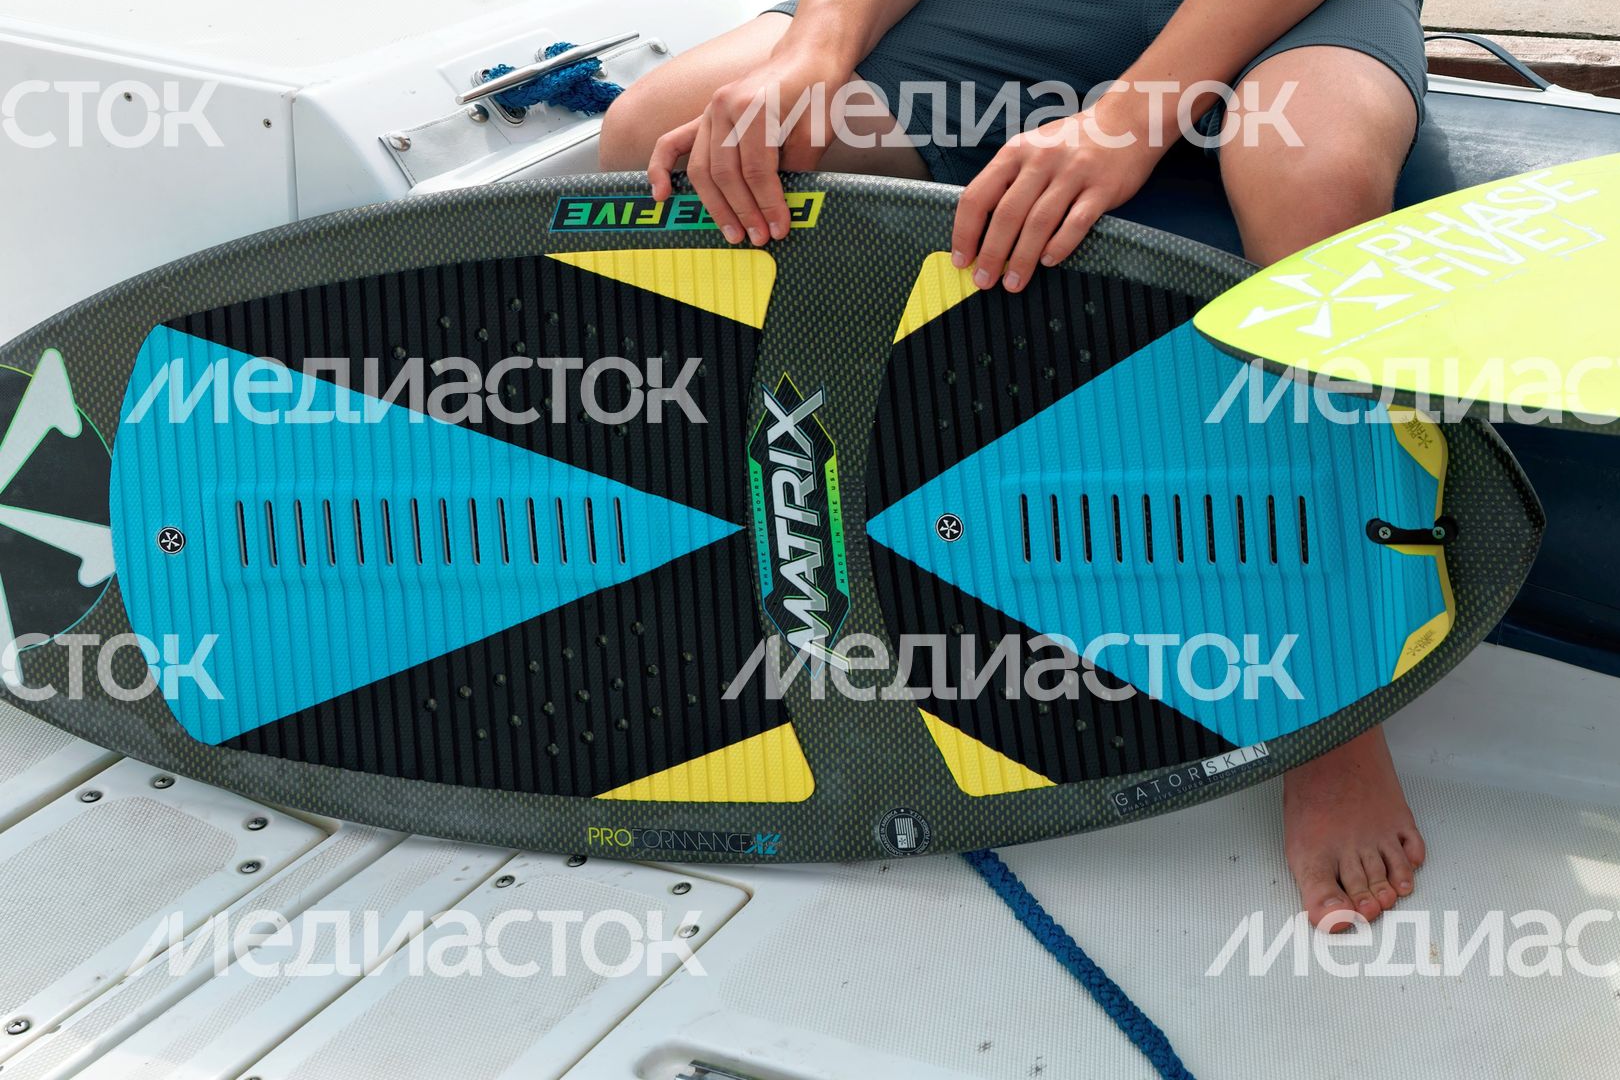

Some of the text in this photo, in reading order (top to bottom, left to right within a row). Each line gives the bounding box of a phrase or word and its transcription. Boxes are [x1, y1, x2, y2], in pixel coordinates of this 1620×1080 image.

[563, 200, 664, 225] FIVE
[1356, 170, 1600, 258] PHASE
[1394, 222, 1570, 292] FIVE
[761, 383, 851, 674] MATRIX
